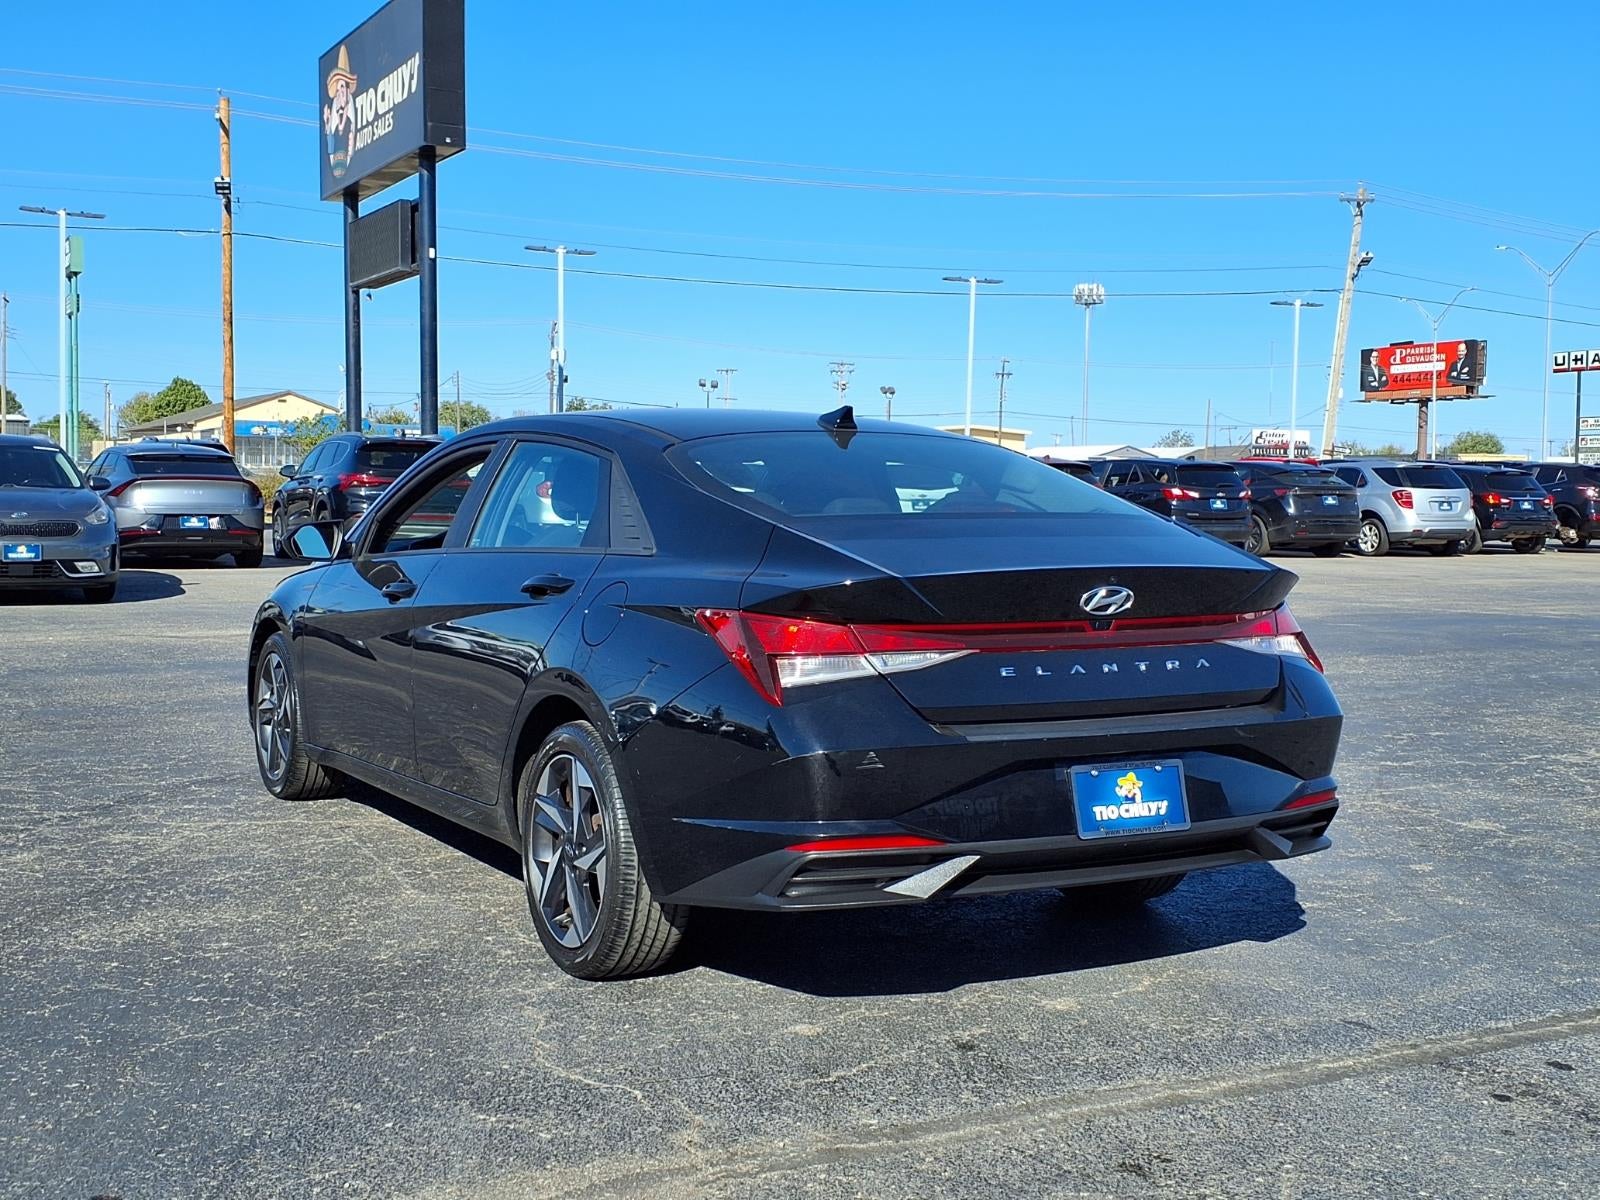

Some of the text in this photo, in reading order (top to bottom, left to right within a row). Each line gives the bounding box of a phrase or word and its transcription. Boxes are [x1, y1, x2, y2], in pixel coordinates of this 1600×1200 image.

[355, 52, 420, 128] TIO CHUY'S
[355, 111, 394, 151] AUTO SALES
[1406, 346, 1437, 355] PARRISH
[1406, 353, 1446, 362] DEVAUGHN
[1000, 658, 1211, 677] ELANTRA
[1092, 799, 1169, 821] TIO CHUY'S
